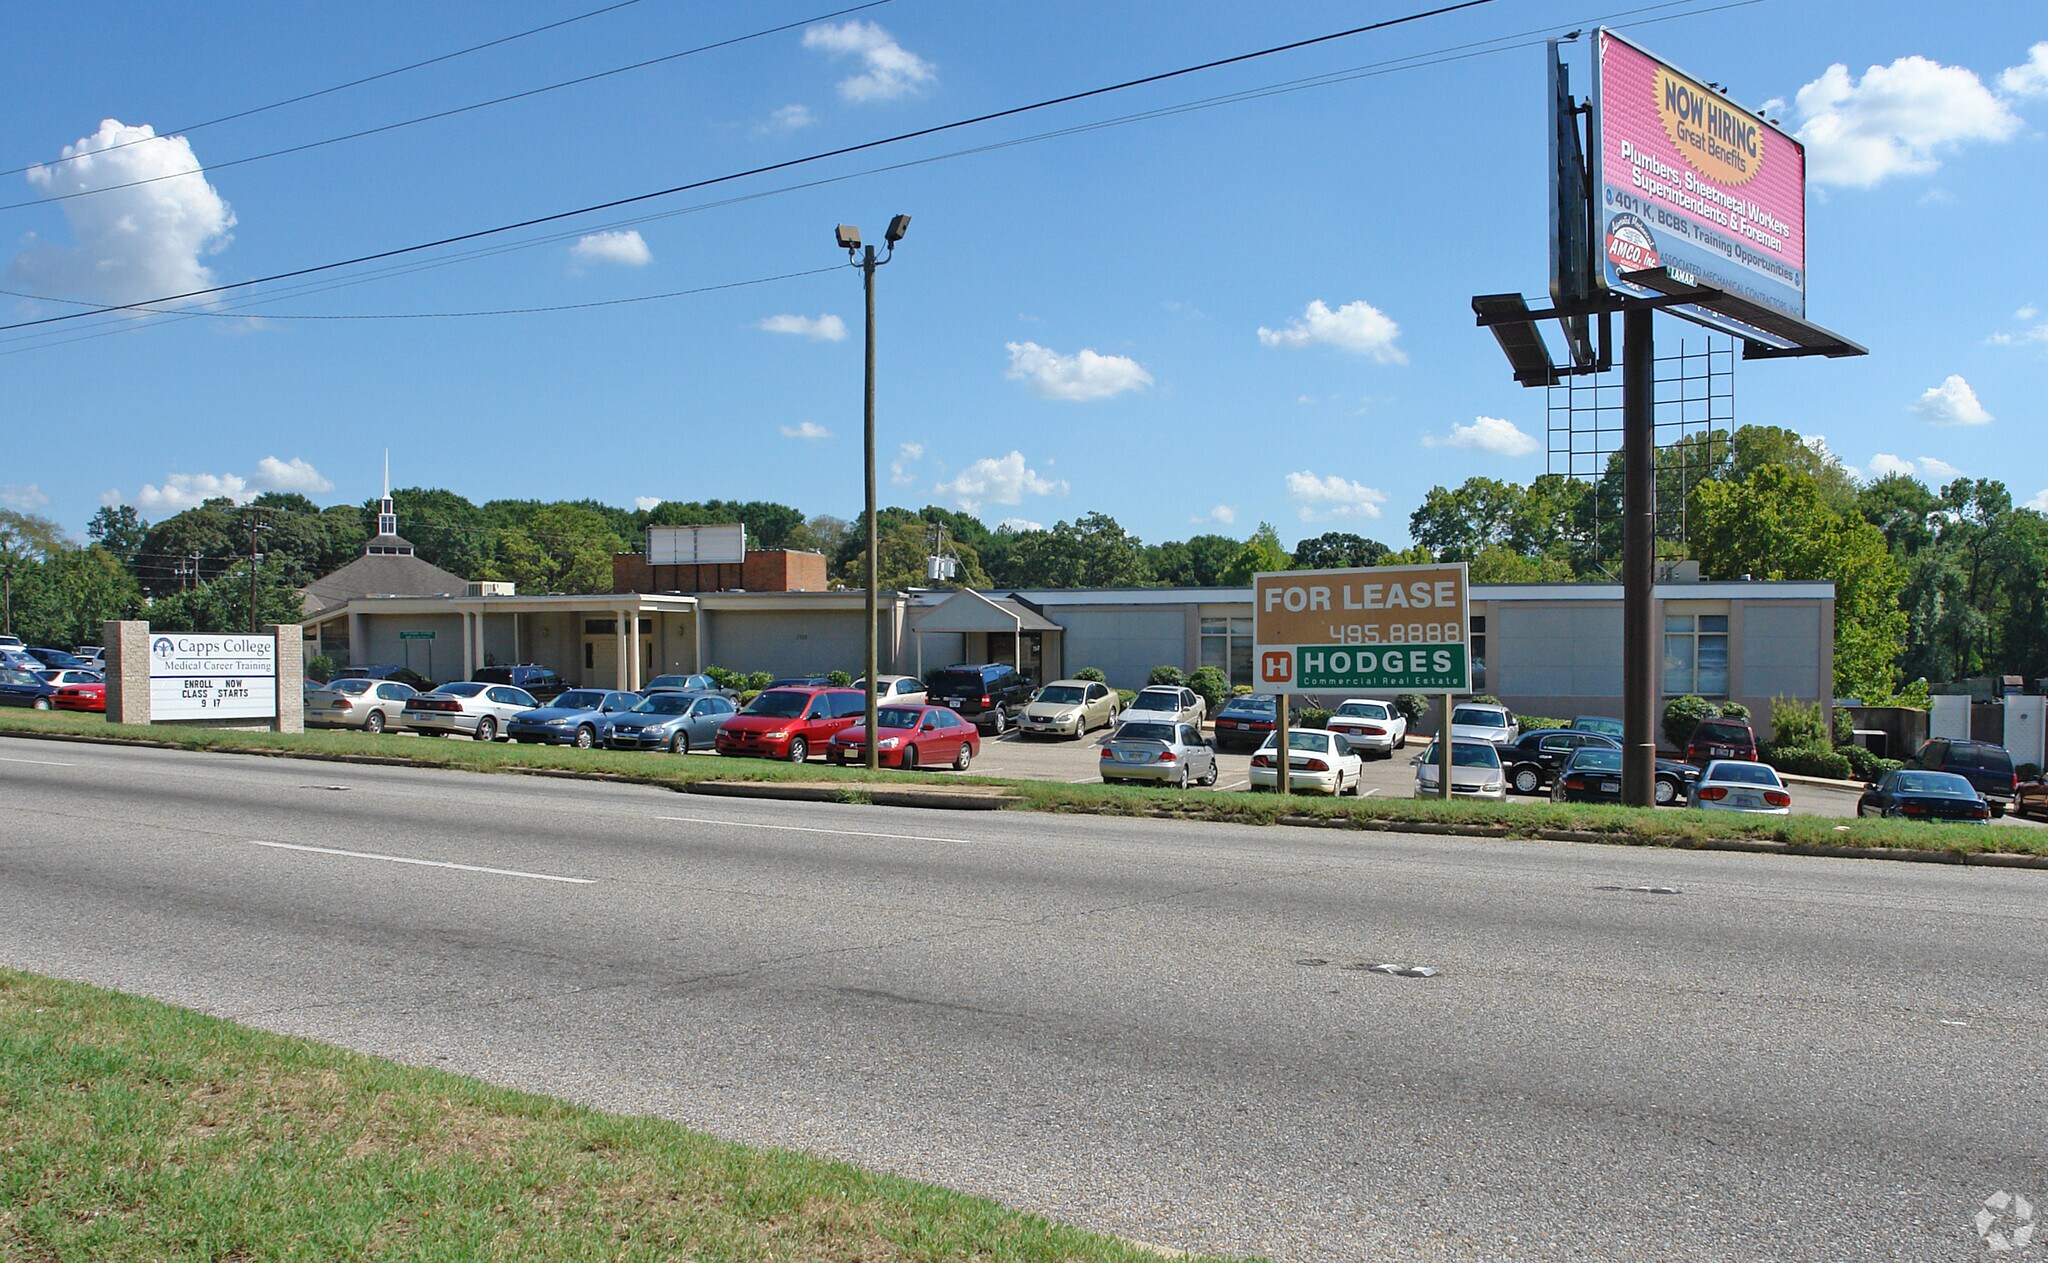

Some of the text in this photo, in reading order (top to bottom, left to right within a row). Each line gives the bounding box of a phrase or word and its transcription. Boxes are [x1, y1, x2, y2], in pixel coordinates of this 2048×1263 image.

[1665, 77, 1757, 158] NOW HIRING
[1677, 119, 1746, 173] Great Benefits
[1621, 139, 1790, 239] Plumbers, Sheetmetal Workers
[1632, 167, 1782, 252] Superintendents & Foremen
[1615, 192, 1639, 214] 401
[1658, 207, 1690, 240] BCBS,
[1693, 225, 1732, 258] Training
[1735, 244, 1793, 281] Opportunities
[1660, 252, 1702, 276] ASSOCIATED
[1671, 267, 1695, 286] LAMAR
[1264, 581, 1456, 613] FOR LEASE
[1329, 622, 1460, 644] 495.8888
[178, 638, 271, 656] Capps College
[165, 661, 271, 672] Medical Career Training
[1266, 657, 1288, 677] H
[1304, 650, 1452, 674] HODGES
[184, 679, 242, 688] ENROLL NOW
[1303, 676, 1458, 685] Commercial Real Estate
[182, 688, 249, 698] CLASS STARTS
[201, 699, 221, 708] 9 17
